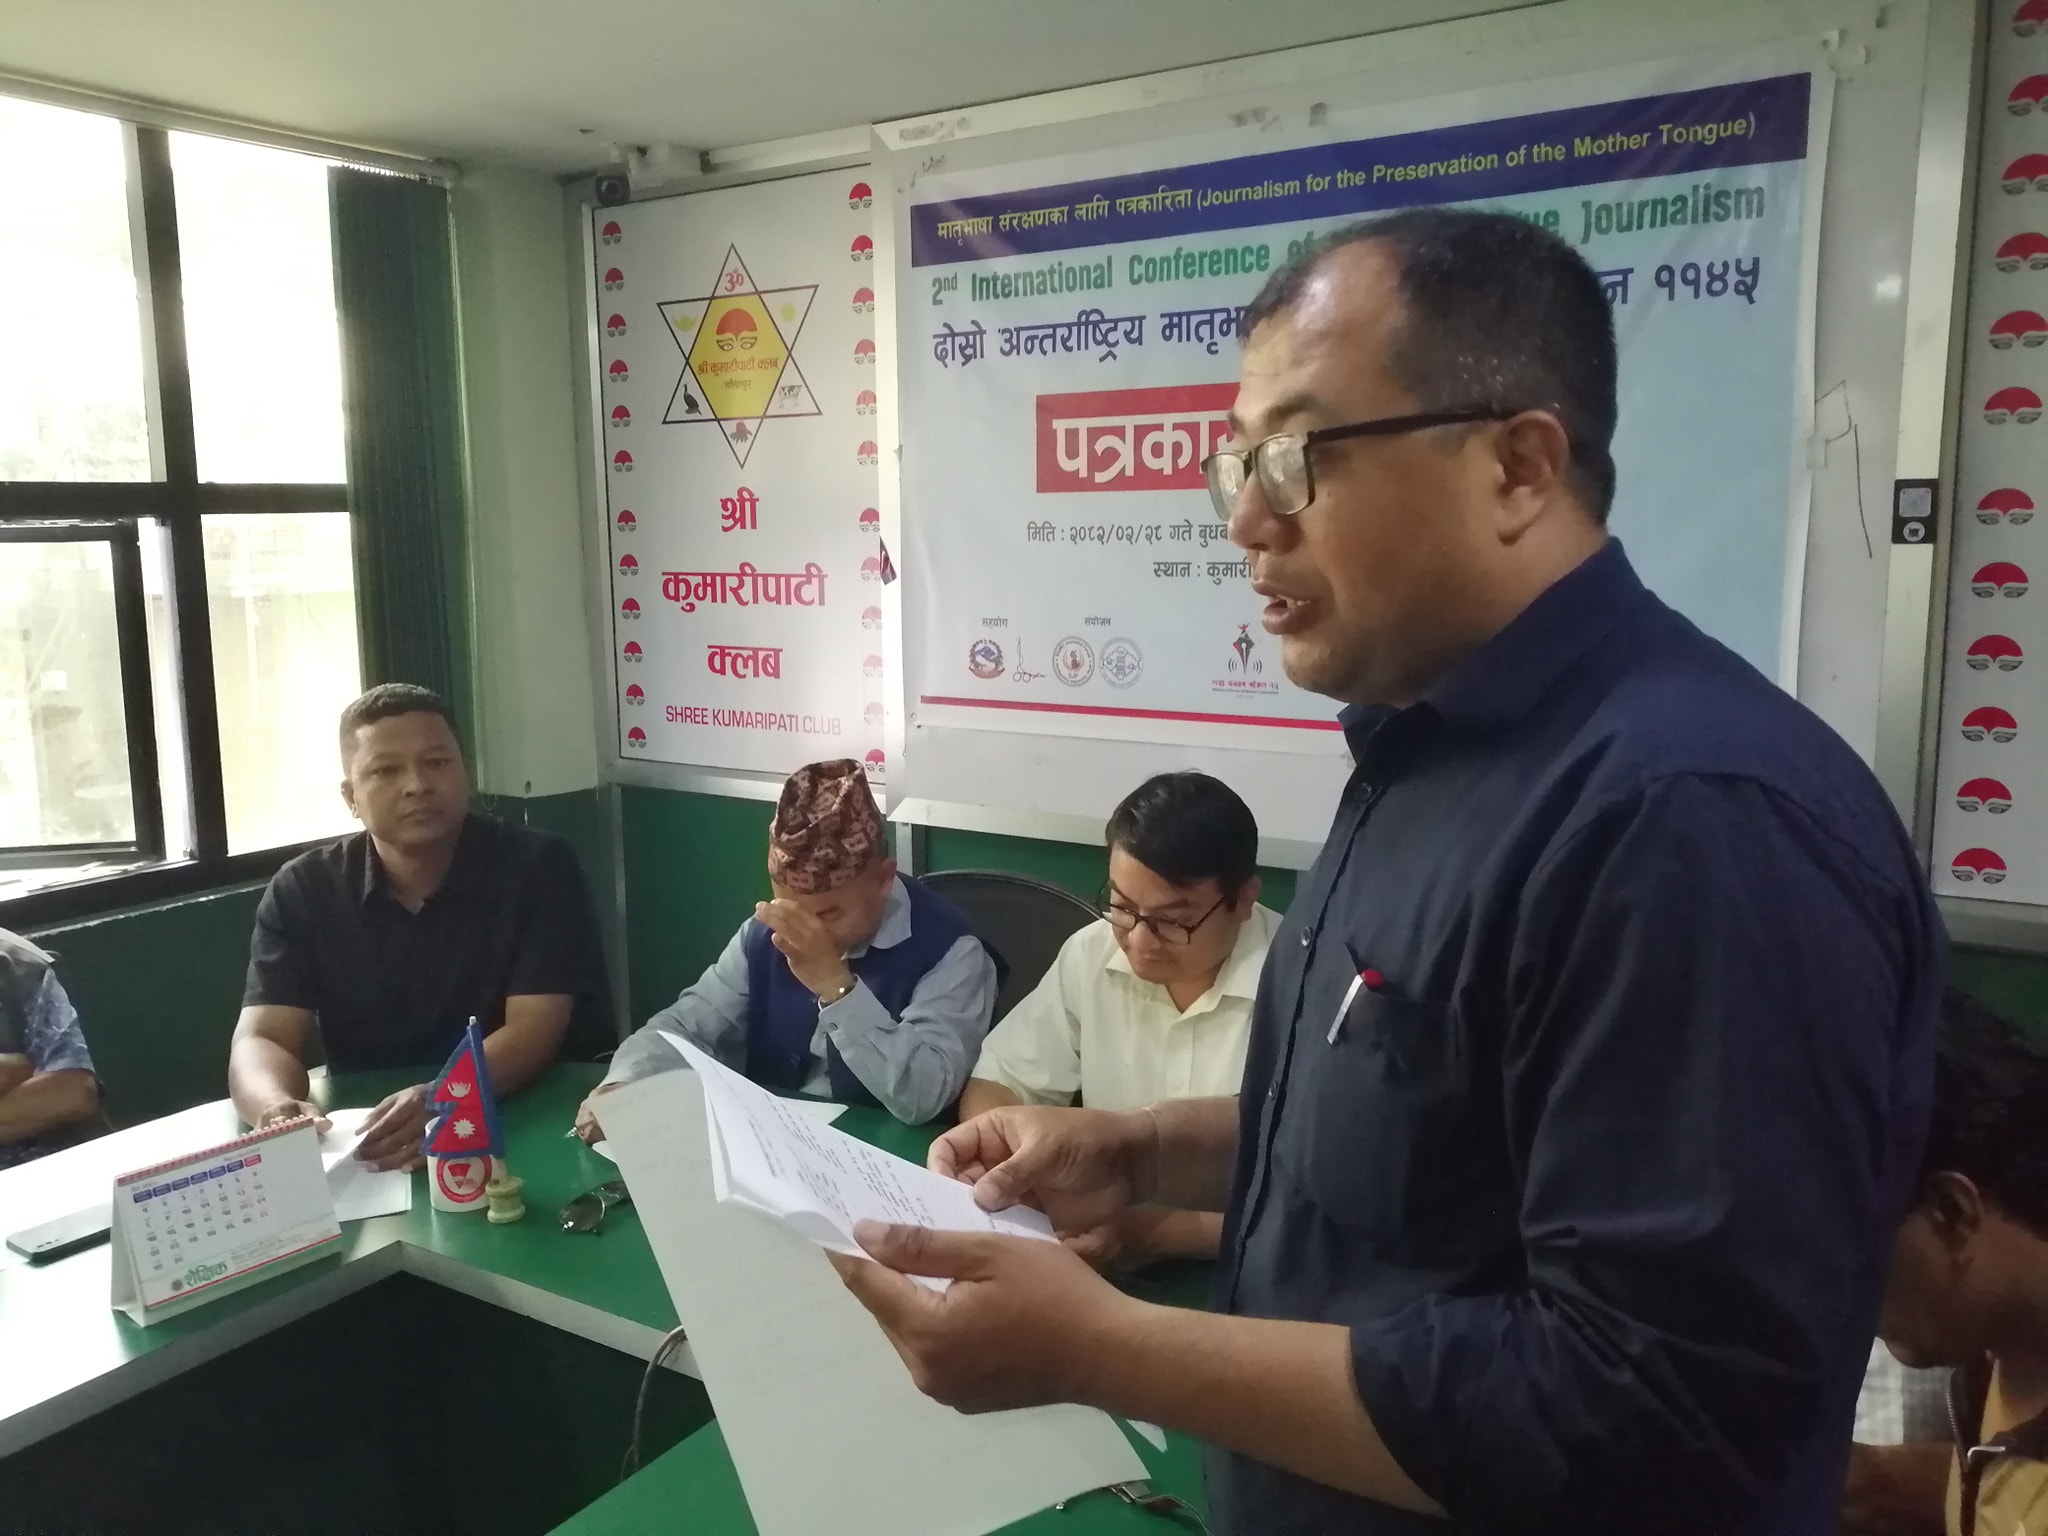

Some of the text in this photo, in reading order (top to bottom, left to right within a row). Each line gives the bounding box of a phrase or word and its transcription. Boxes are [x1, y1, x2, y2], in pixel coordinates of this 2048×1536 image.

[937, 111, 1756, 246] मातृभाषा संरक्षणका लागि पत्रकारिता (Journalism for the Preservation of the Mother Tongue)
[932, 272, 958, 306] 2nd
[971, 256, 1113, 302] International
[1128, 241, 1270, 287] Conference
[1581, 182, 1765, 244] Journalism
[933, 319, 987, 368] दोस्रो
[999, 308, 1147, 363] अन्तर्राष्ट्रिय
[1160, 306, 1246, 355] मातृभ
[1654, 256, 1760, 304] ११४५
[720, 486, 760, 532] श्री
[1027, 521, 1057, 542] मिति
[1069, 524, 1162, 545] २०८२/०२/२८
[1169, 519, 1193, 541] गते
[1198, 524, 1229, 548] बुधब
[661, 561, 828, 613] कुमारीपाटी
[1153, 561, 1192, 578] स्थान
[1206, 556, 1252, 586] कुमारी
[982, 615, 1008, 628] सहयोग
[1084, 615, 1112, 627] संयोजन
[707, 644, 784, 679] क्लब
[665, 705, 842, 736] SHREE KUMARIPATI CLUB
